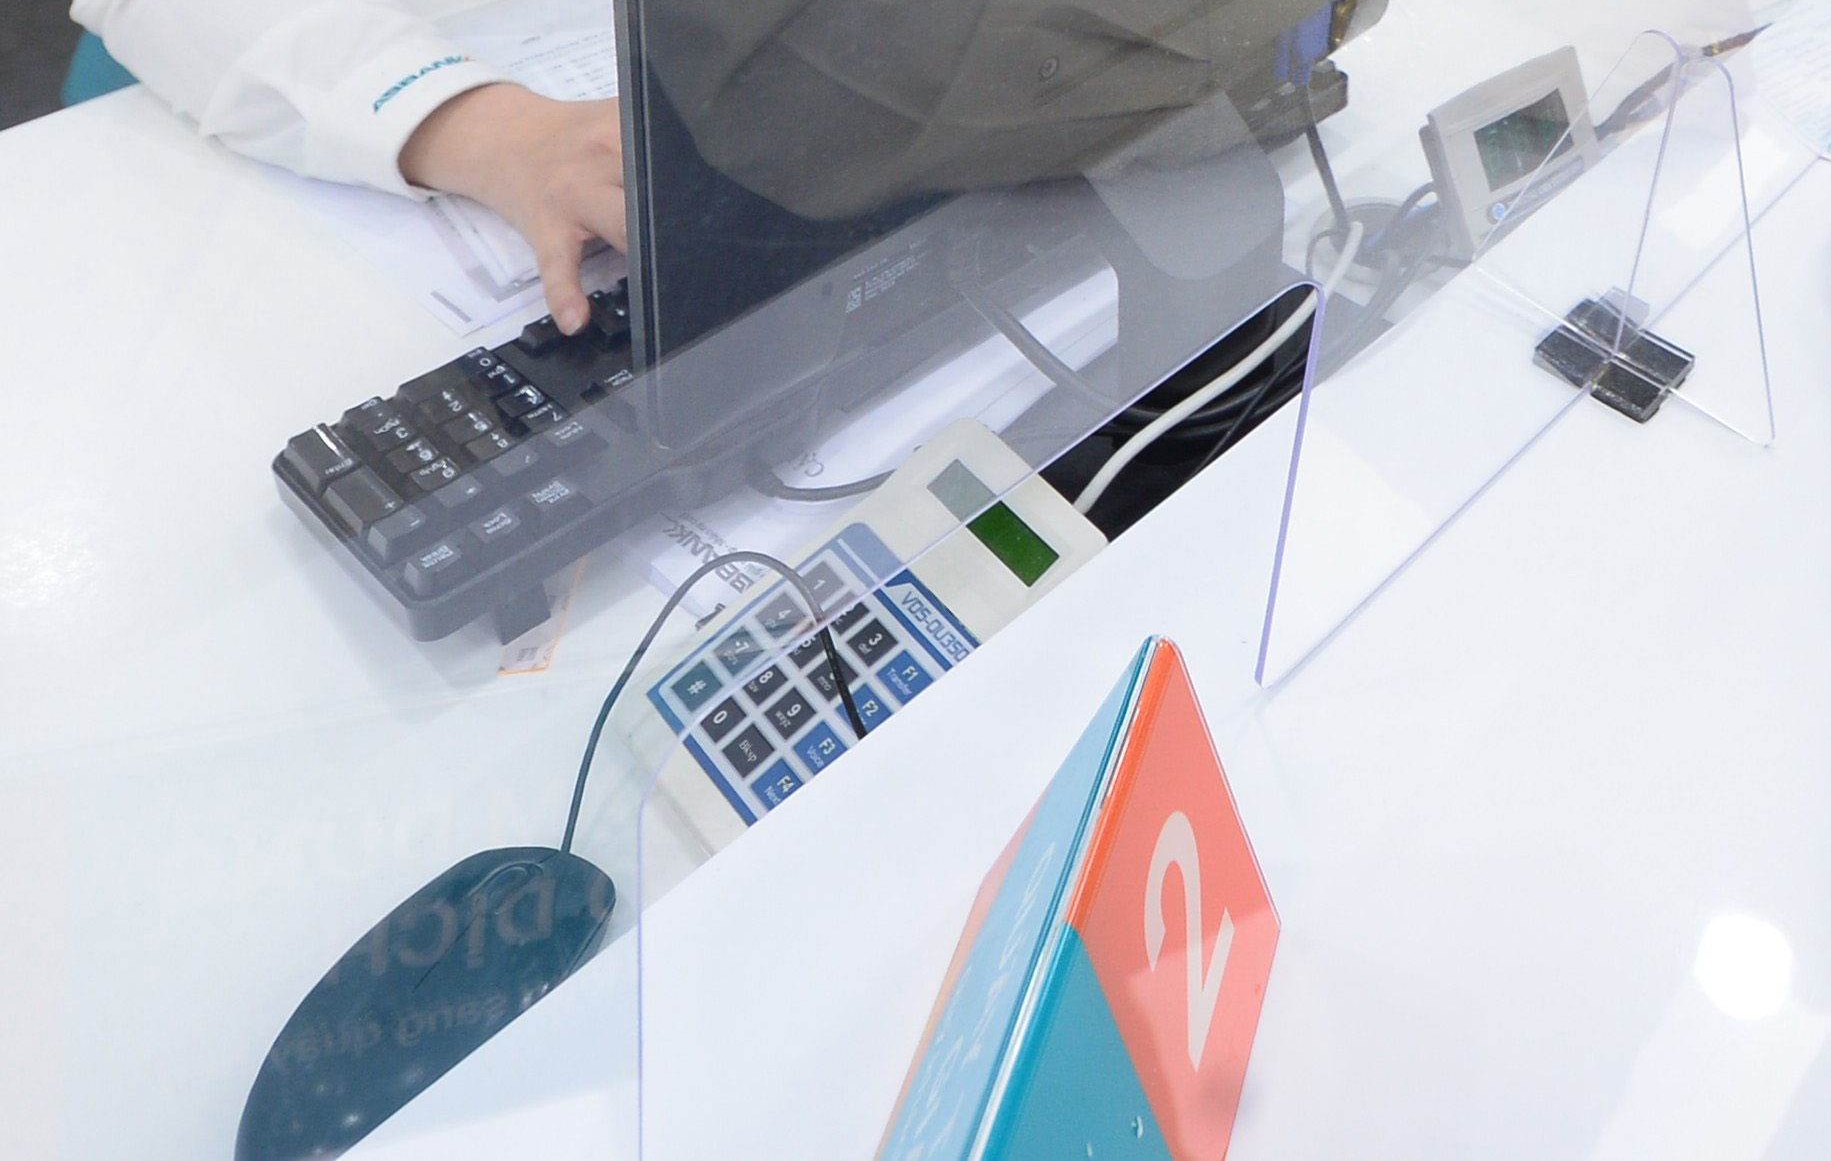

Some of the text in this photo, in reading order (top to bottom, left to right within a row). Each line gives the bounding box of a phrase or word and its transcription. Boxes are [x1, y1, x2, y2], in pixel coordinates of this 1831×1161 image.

[396, 428, 408, 439] 3
[665, 524, 755, 594] BBANK
[813, 579, 826, 590] 1
[777, 609, 792, 621] 4
[735, 640, 750, 654] 7
[868, 633, 883, 646] 3
[758, 670, 775, 684] 8
[886, 667, 913, 696] Transfer
[902, 665, 919, 682] F1
[786, 703, 802, 717] 9
[861, 699, 879, 717] F2
[712, 710, 728, 724] 0
[738, 738, 757, 763] Bksp
[818, 737, 836, 755] F3
[806, 745, 824, 768] Voice
[777, 775, 795, 794] F4
[1144, 810, 1236, 1074] 2
